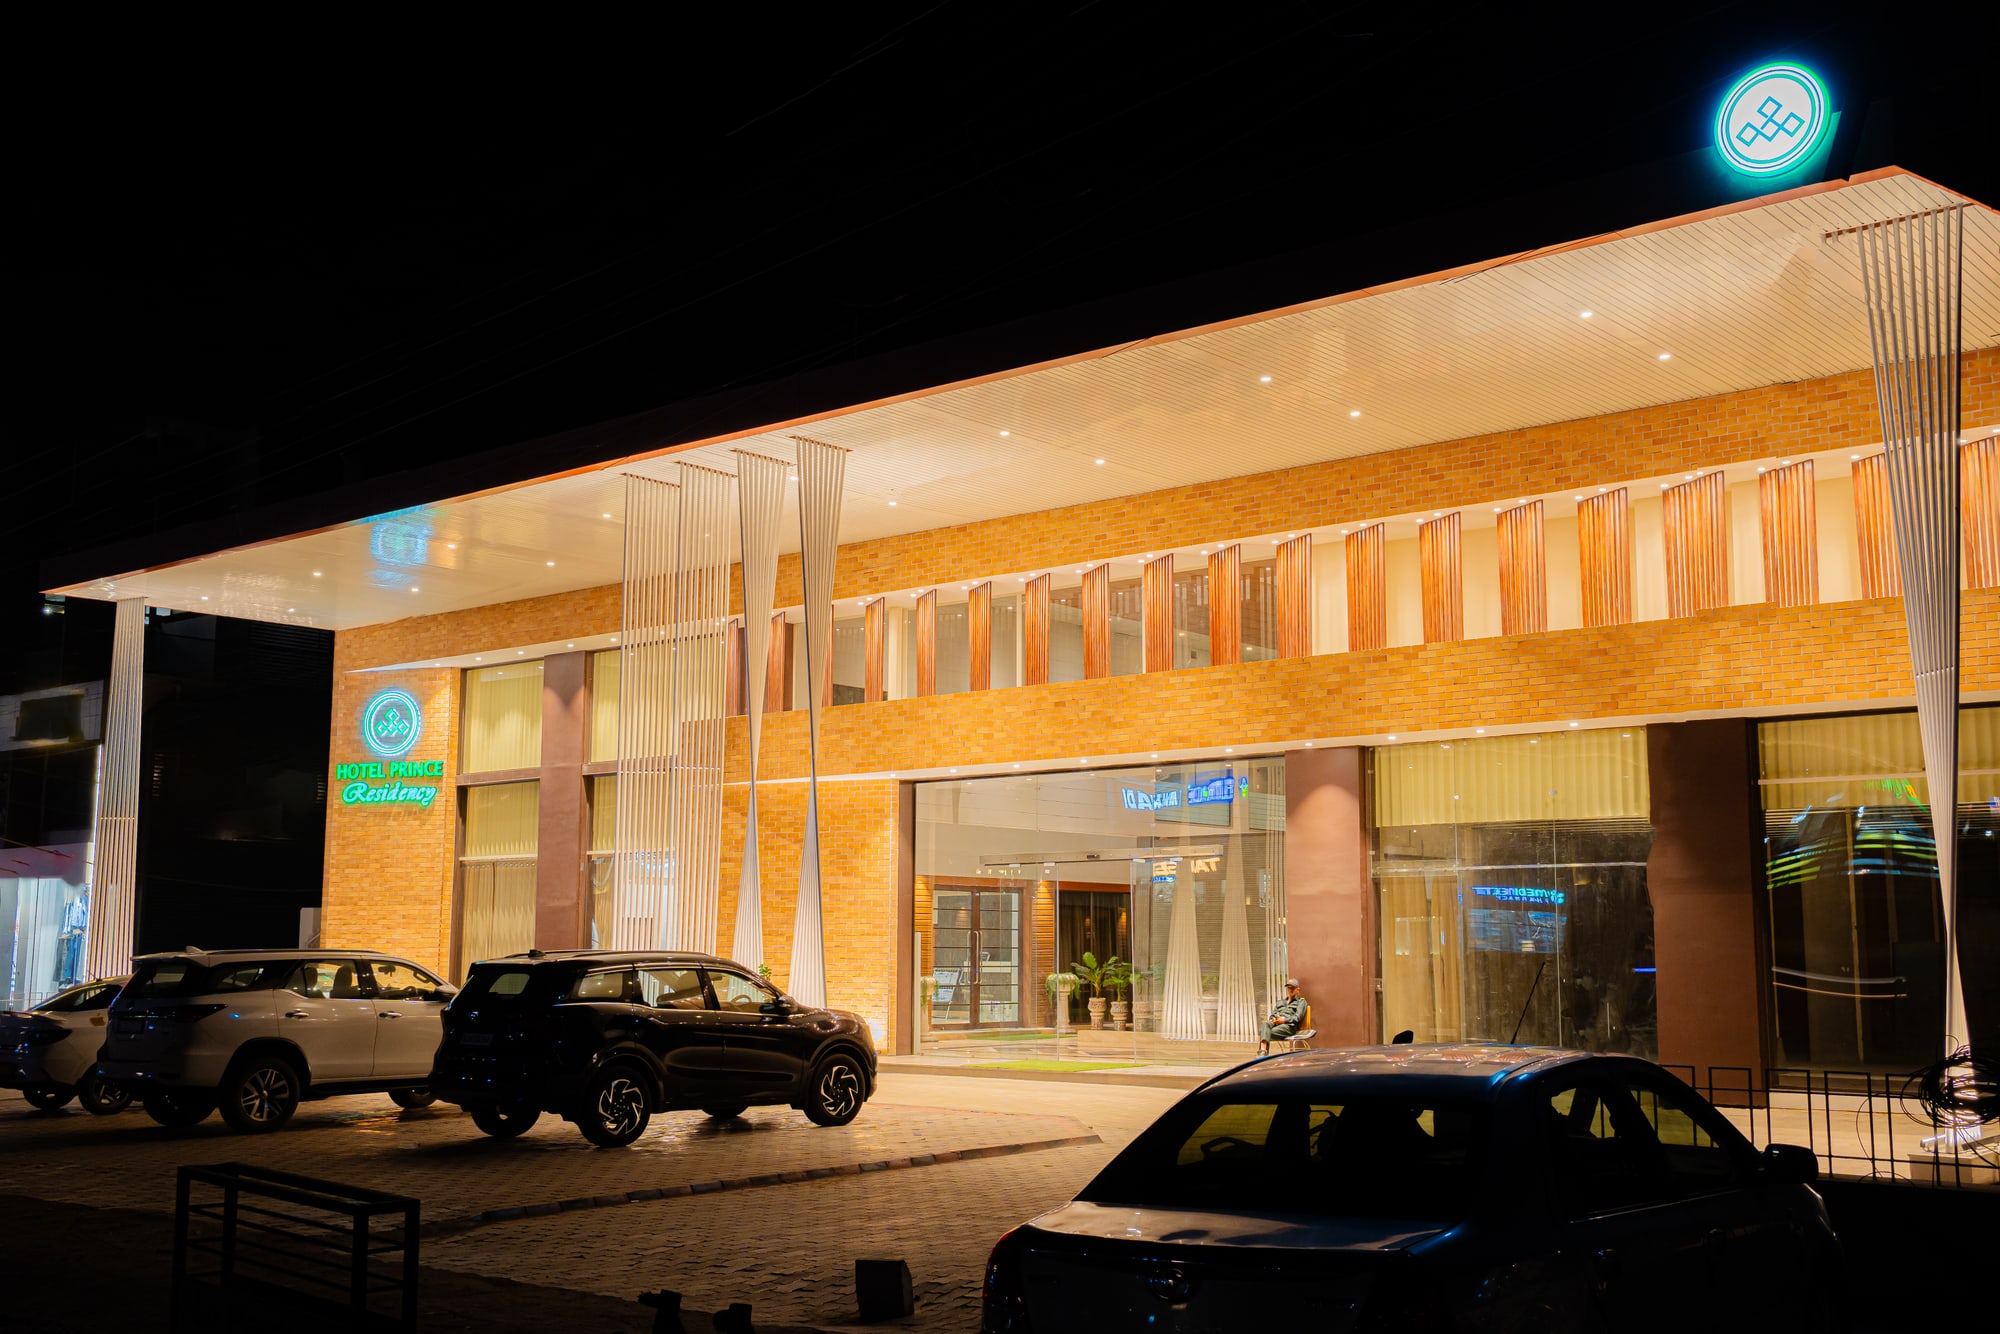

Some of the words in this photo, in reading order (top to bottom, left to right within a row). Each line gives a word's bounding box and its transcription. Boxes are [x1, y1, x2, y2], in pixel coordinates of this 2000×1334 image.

[336, 763, 386, 780] HOTEL
[389, 760, 443, 777] PRINCE
[342, 781, 437, 807] Residency
